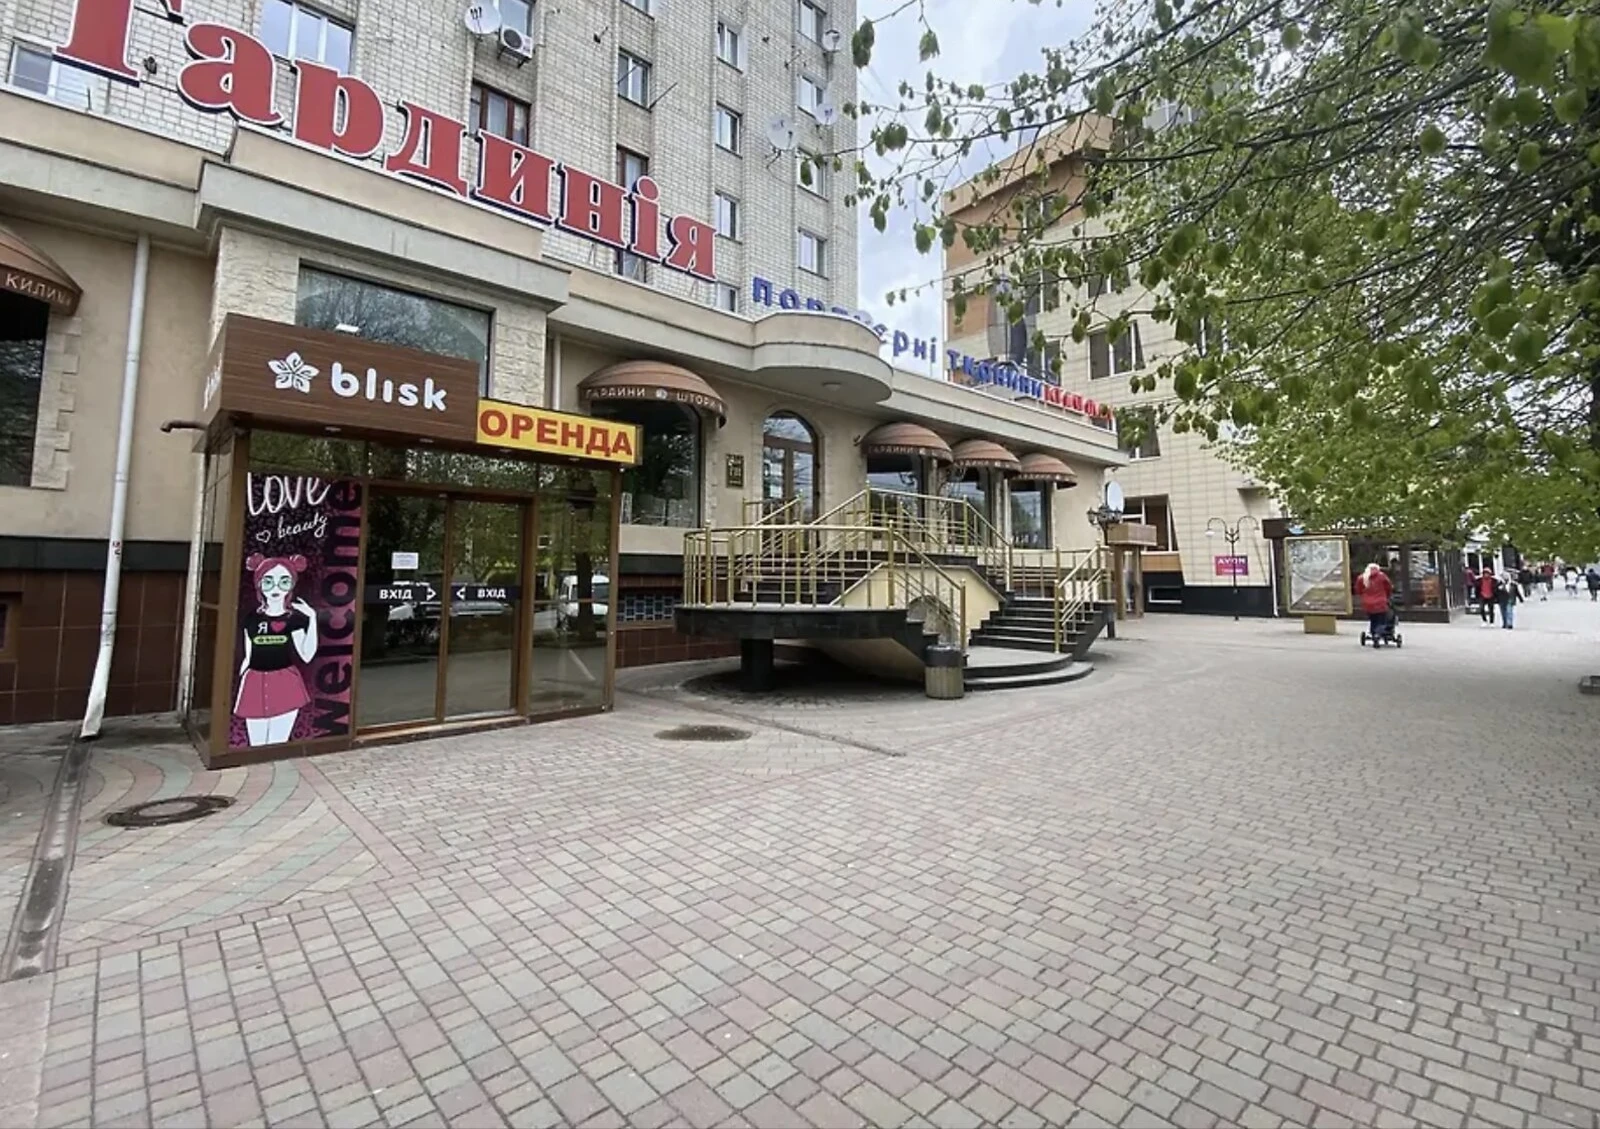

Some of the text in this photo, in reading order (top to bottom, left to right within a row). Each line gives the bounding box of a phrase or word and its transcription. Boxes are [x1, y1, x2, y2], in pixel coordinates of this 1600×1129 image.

[52, 0, 718, 284] Гардинія
[331, 361, 447, 412] blisk
[479, 409, 633, 457] ОРЕНДА
[277, 512, 328, 539] beauty
[313, 479, 363, 738] welcome
[379, 588, 413, 600] ВХІД
[477, 587, 507, 599] ВХІД
[257, 621, 268, 634] Я
